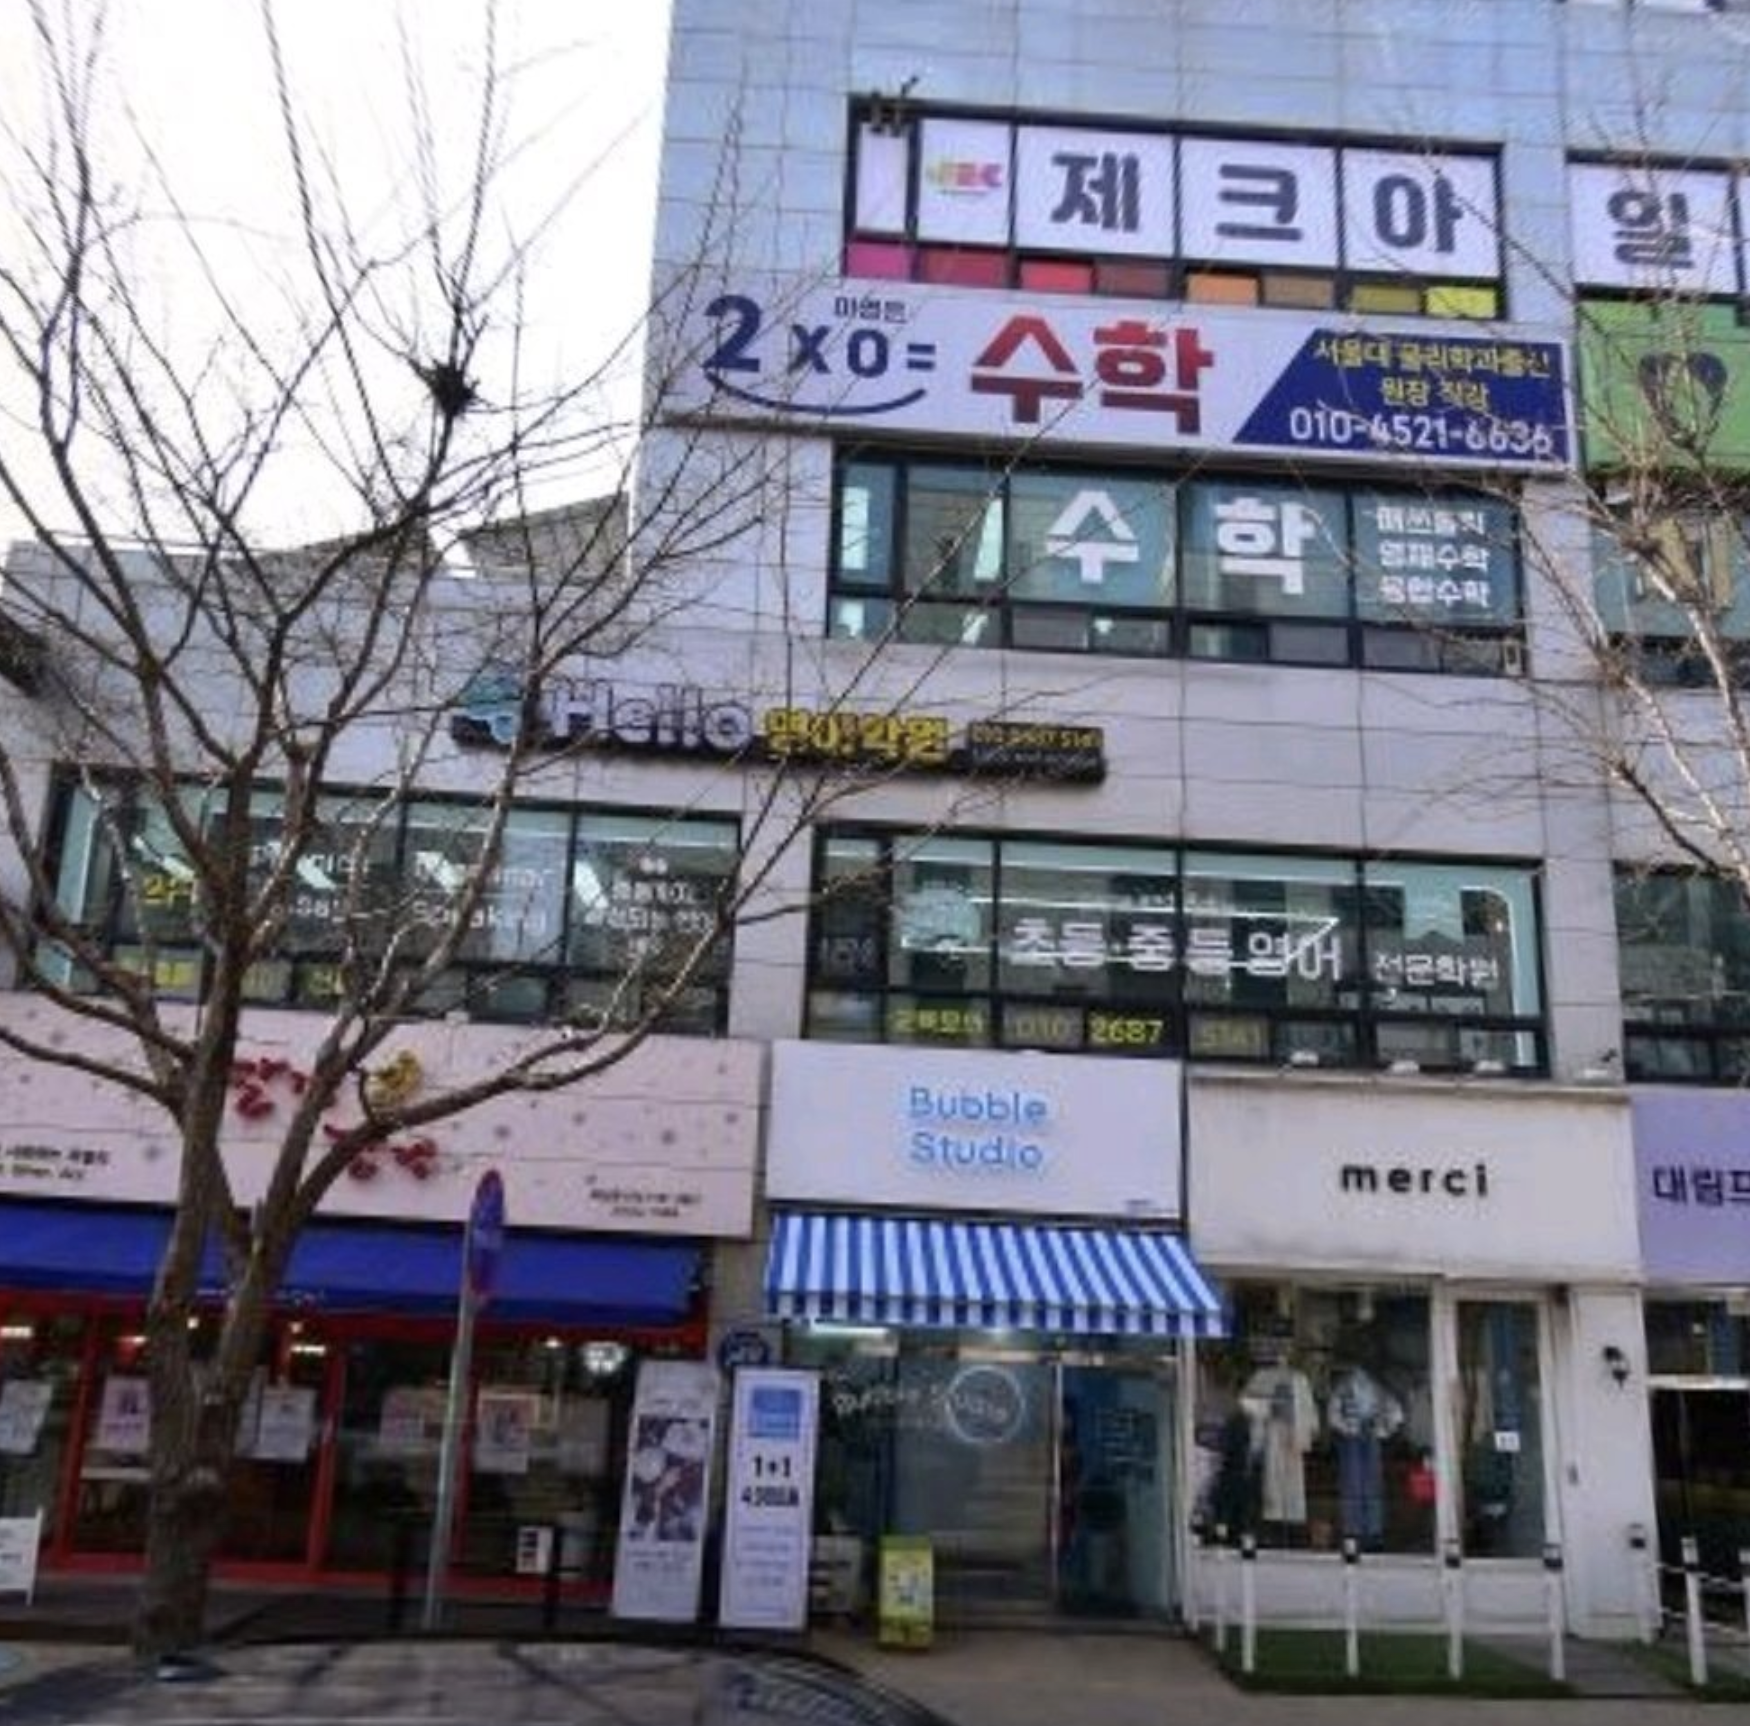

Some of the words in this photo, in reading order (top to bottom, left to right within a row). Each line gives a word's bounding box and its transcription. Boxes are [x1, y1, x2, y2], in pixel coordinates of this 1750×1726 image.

[1314, 336, 1391, 369] 서울대
[970, 313, 1214, 436] 수학
[1379, 375, 1429, 408] 원장
[1043, 489, 1318, 596] 수학
[549, 677, 753, 751] Hello
[907, 1085, 1048, 1127] Bubble
[908, 1130, 1045, 1172] Studio
[1340, 1163, 1489, 1198] merci
[751, 1454, 793, 1480] 1+1
